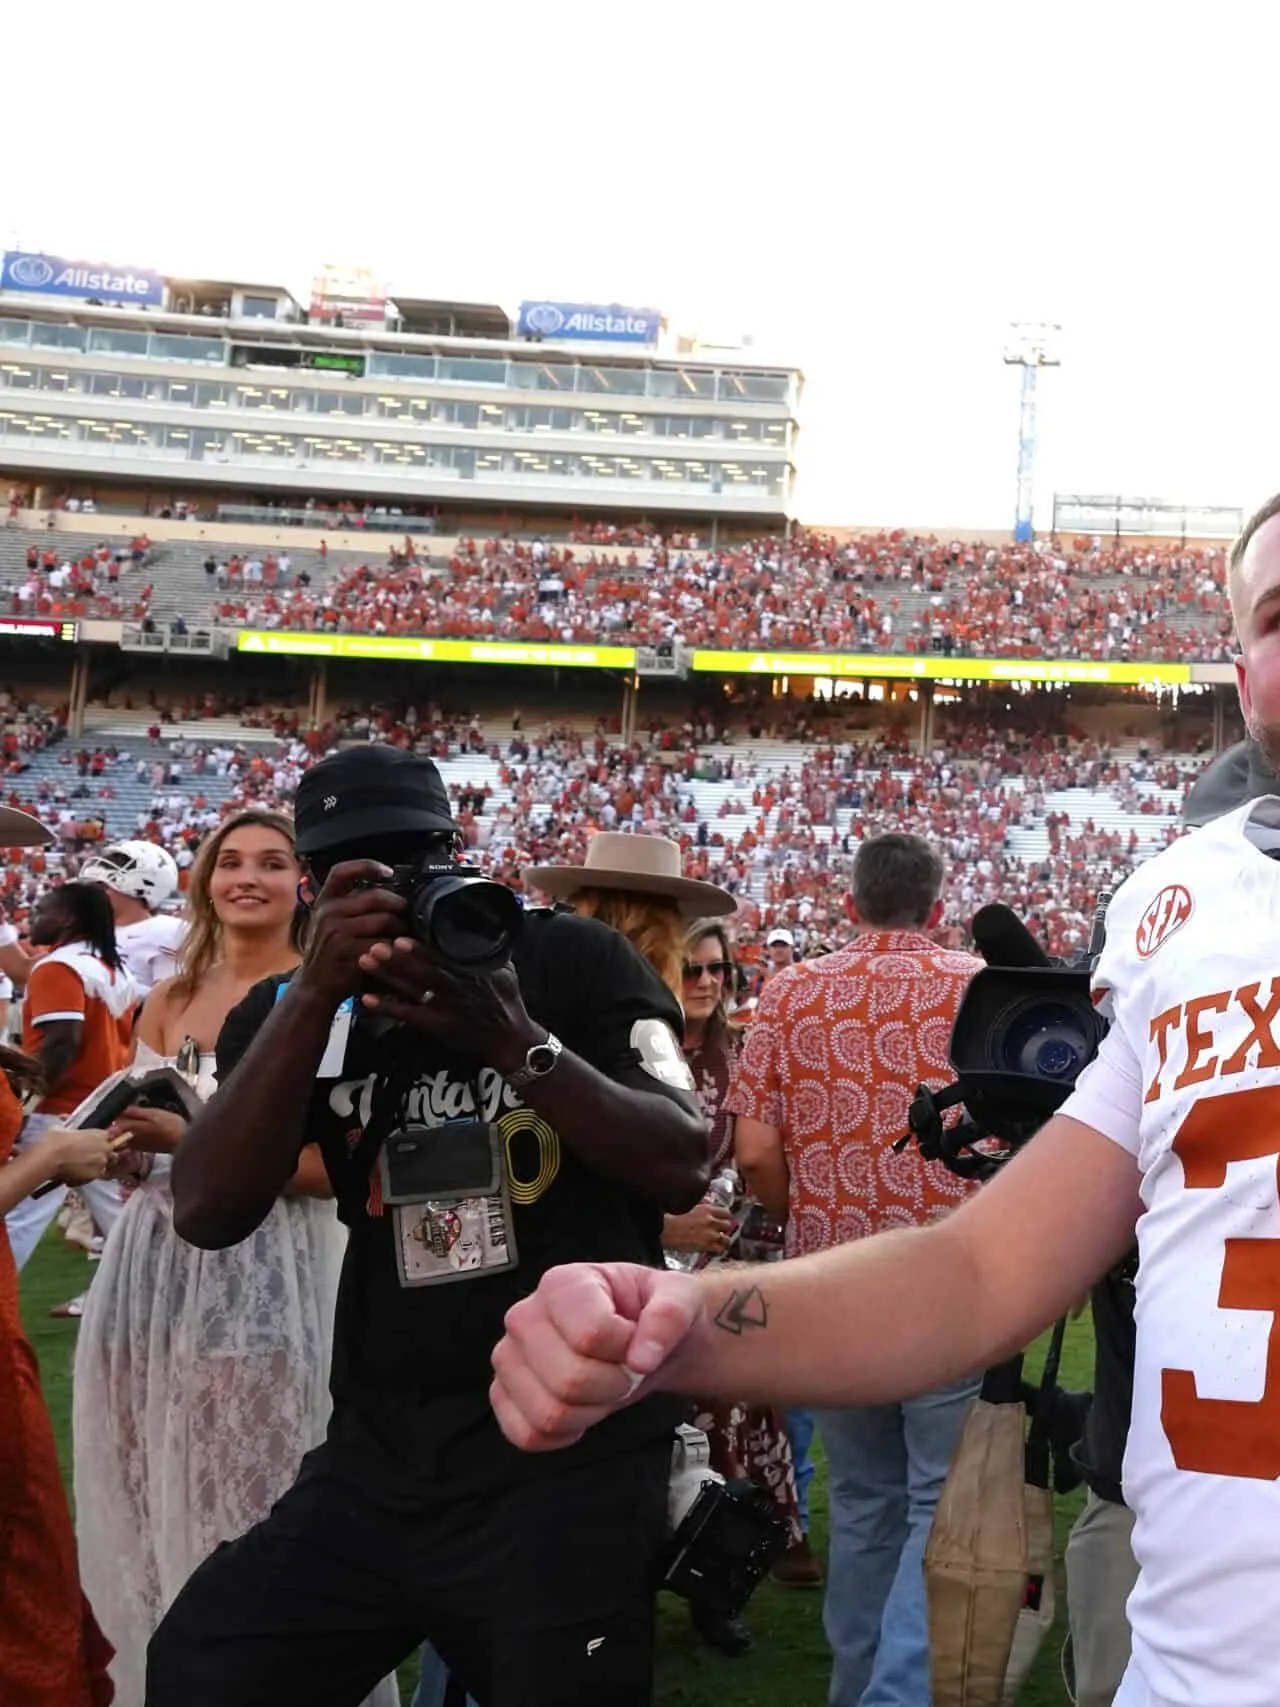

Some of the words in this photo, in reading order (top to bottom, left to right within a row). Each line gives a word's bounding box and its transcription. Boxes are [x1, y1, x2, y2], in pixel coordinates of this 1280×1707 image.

[53, 266, 149, 295] Allstate
[563, 311, 647, 335] Allstate
[1136, 886, 1192, 957] SEC
[329, 1067, 525, 1128] Vntage
